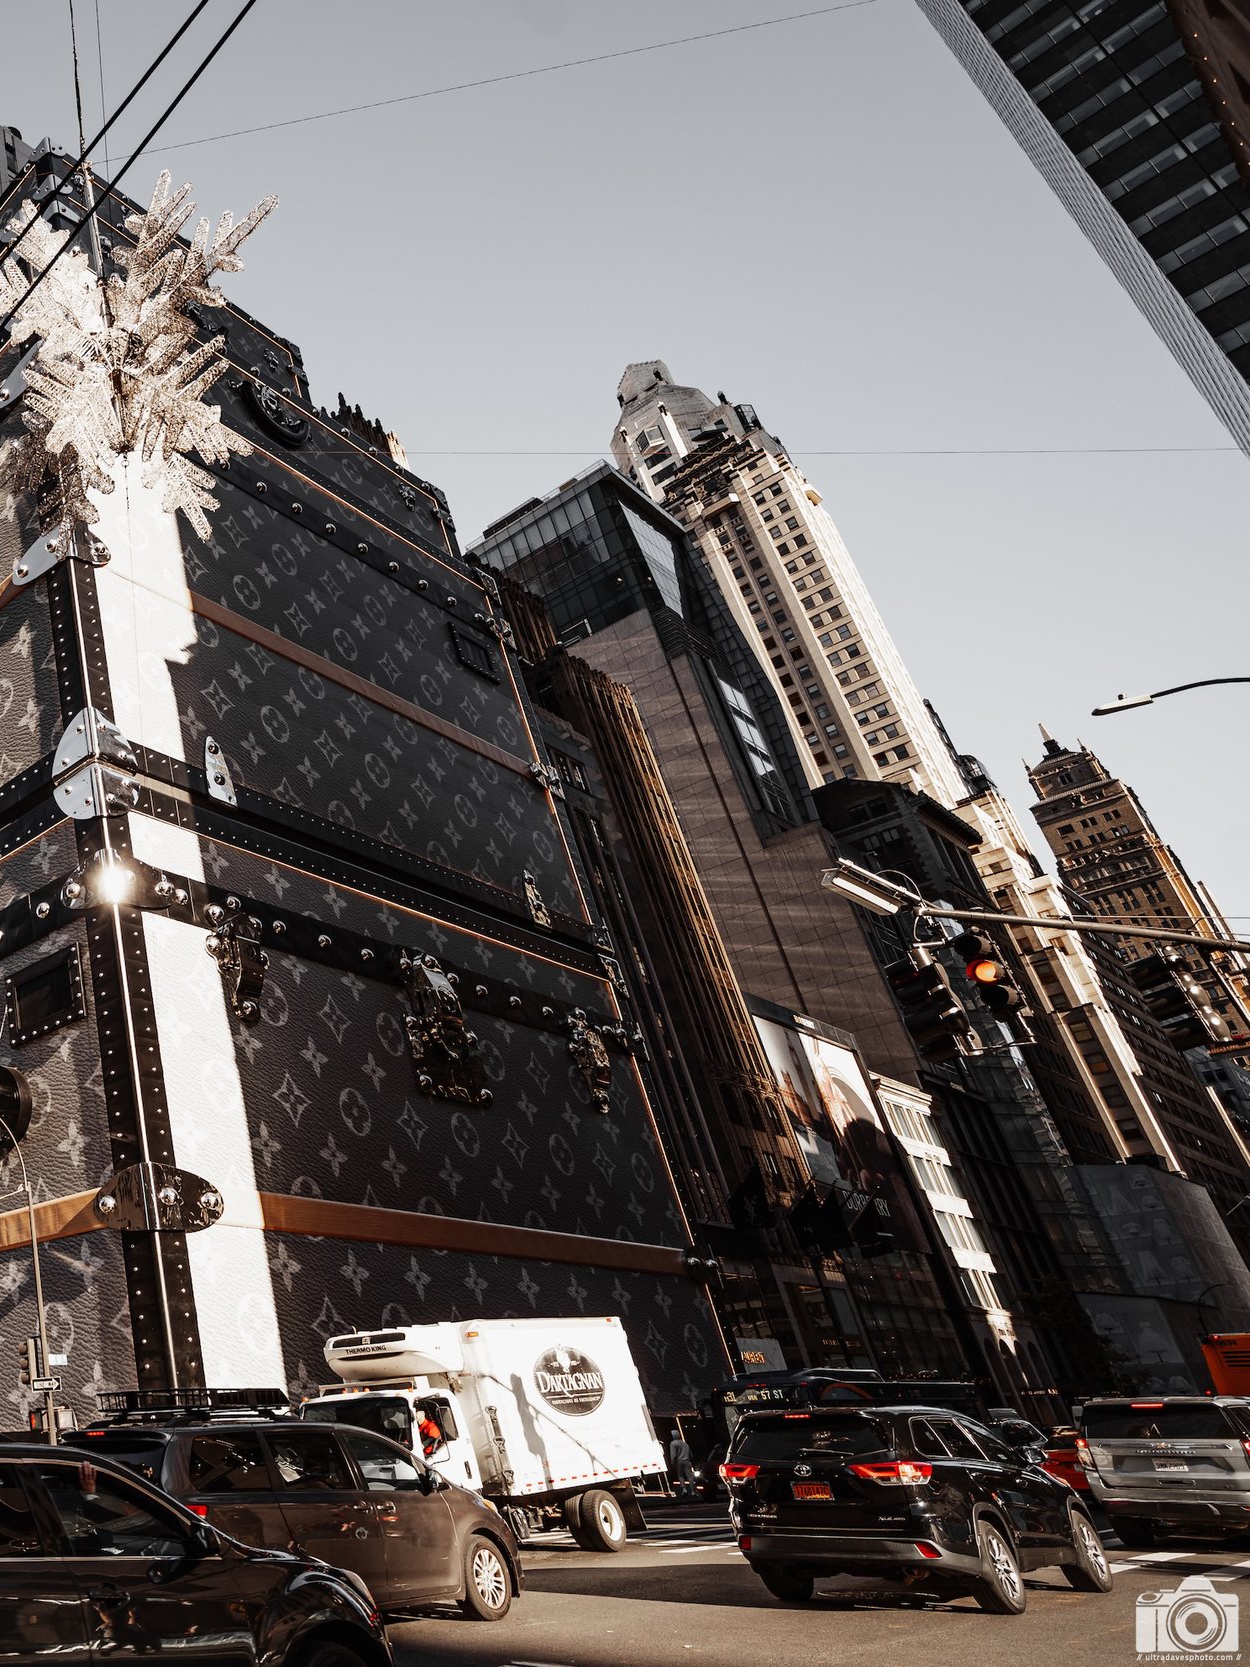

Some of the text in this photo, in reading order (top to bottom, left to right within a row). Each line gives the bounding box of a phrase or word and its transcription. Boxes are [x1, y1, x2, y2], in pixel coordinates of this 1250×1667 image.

[345, 1345, 387, 1355] THERMO KING
[760, 1390, 771, 1400] 57
[772, 1389, 784, 1400] ST
